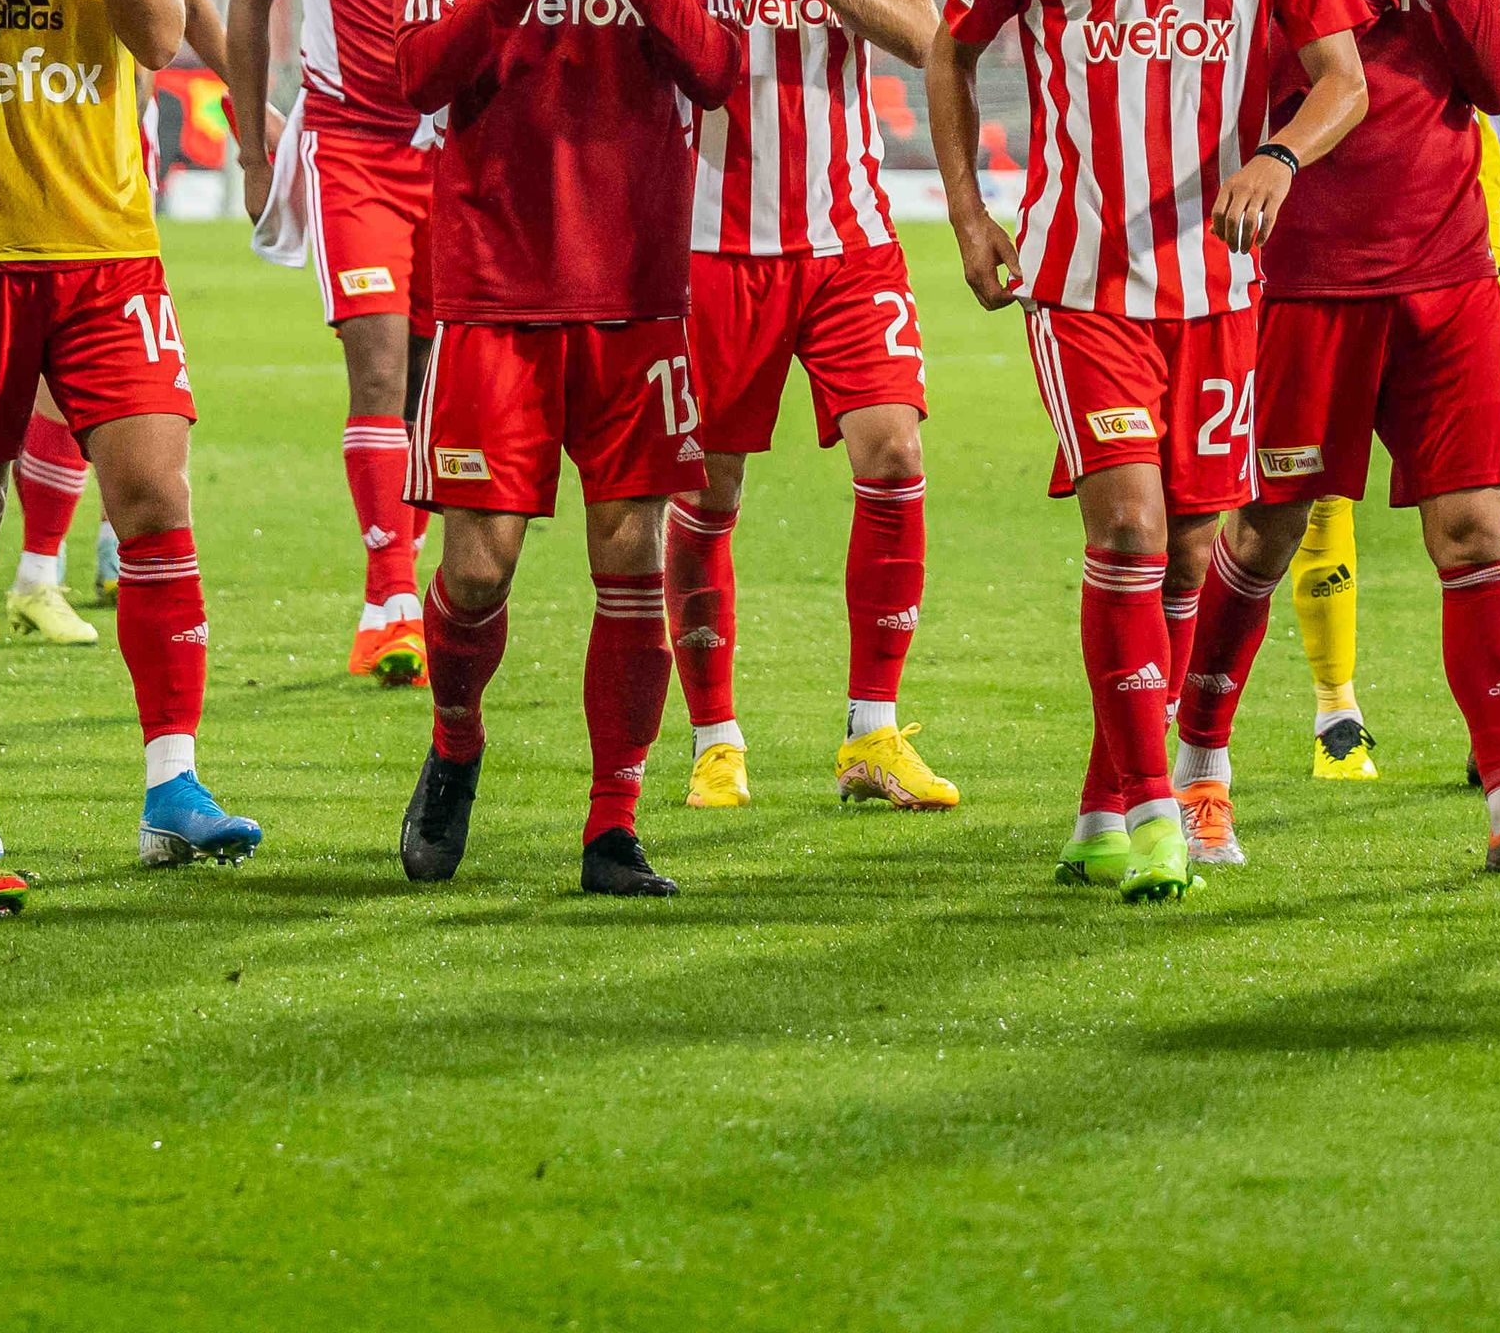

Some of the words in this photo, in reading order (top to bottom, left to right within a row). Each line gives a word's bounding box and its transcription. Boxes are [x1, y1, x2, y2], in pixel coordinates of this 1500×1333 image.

[1082, 4, 1236, 62] wefox
[123, 293, 188, 365] 14
[645, 355, 701, 437] 13
[1197, 367, 1256, 456] 24
[1116, 677, 1168, 692] adidas
